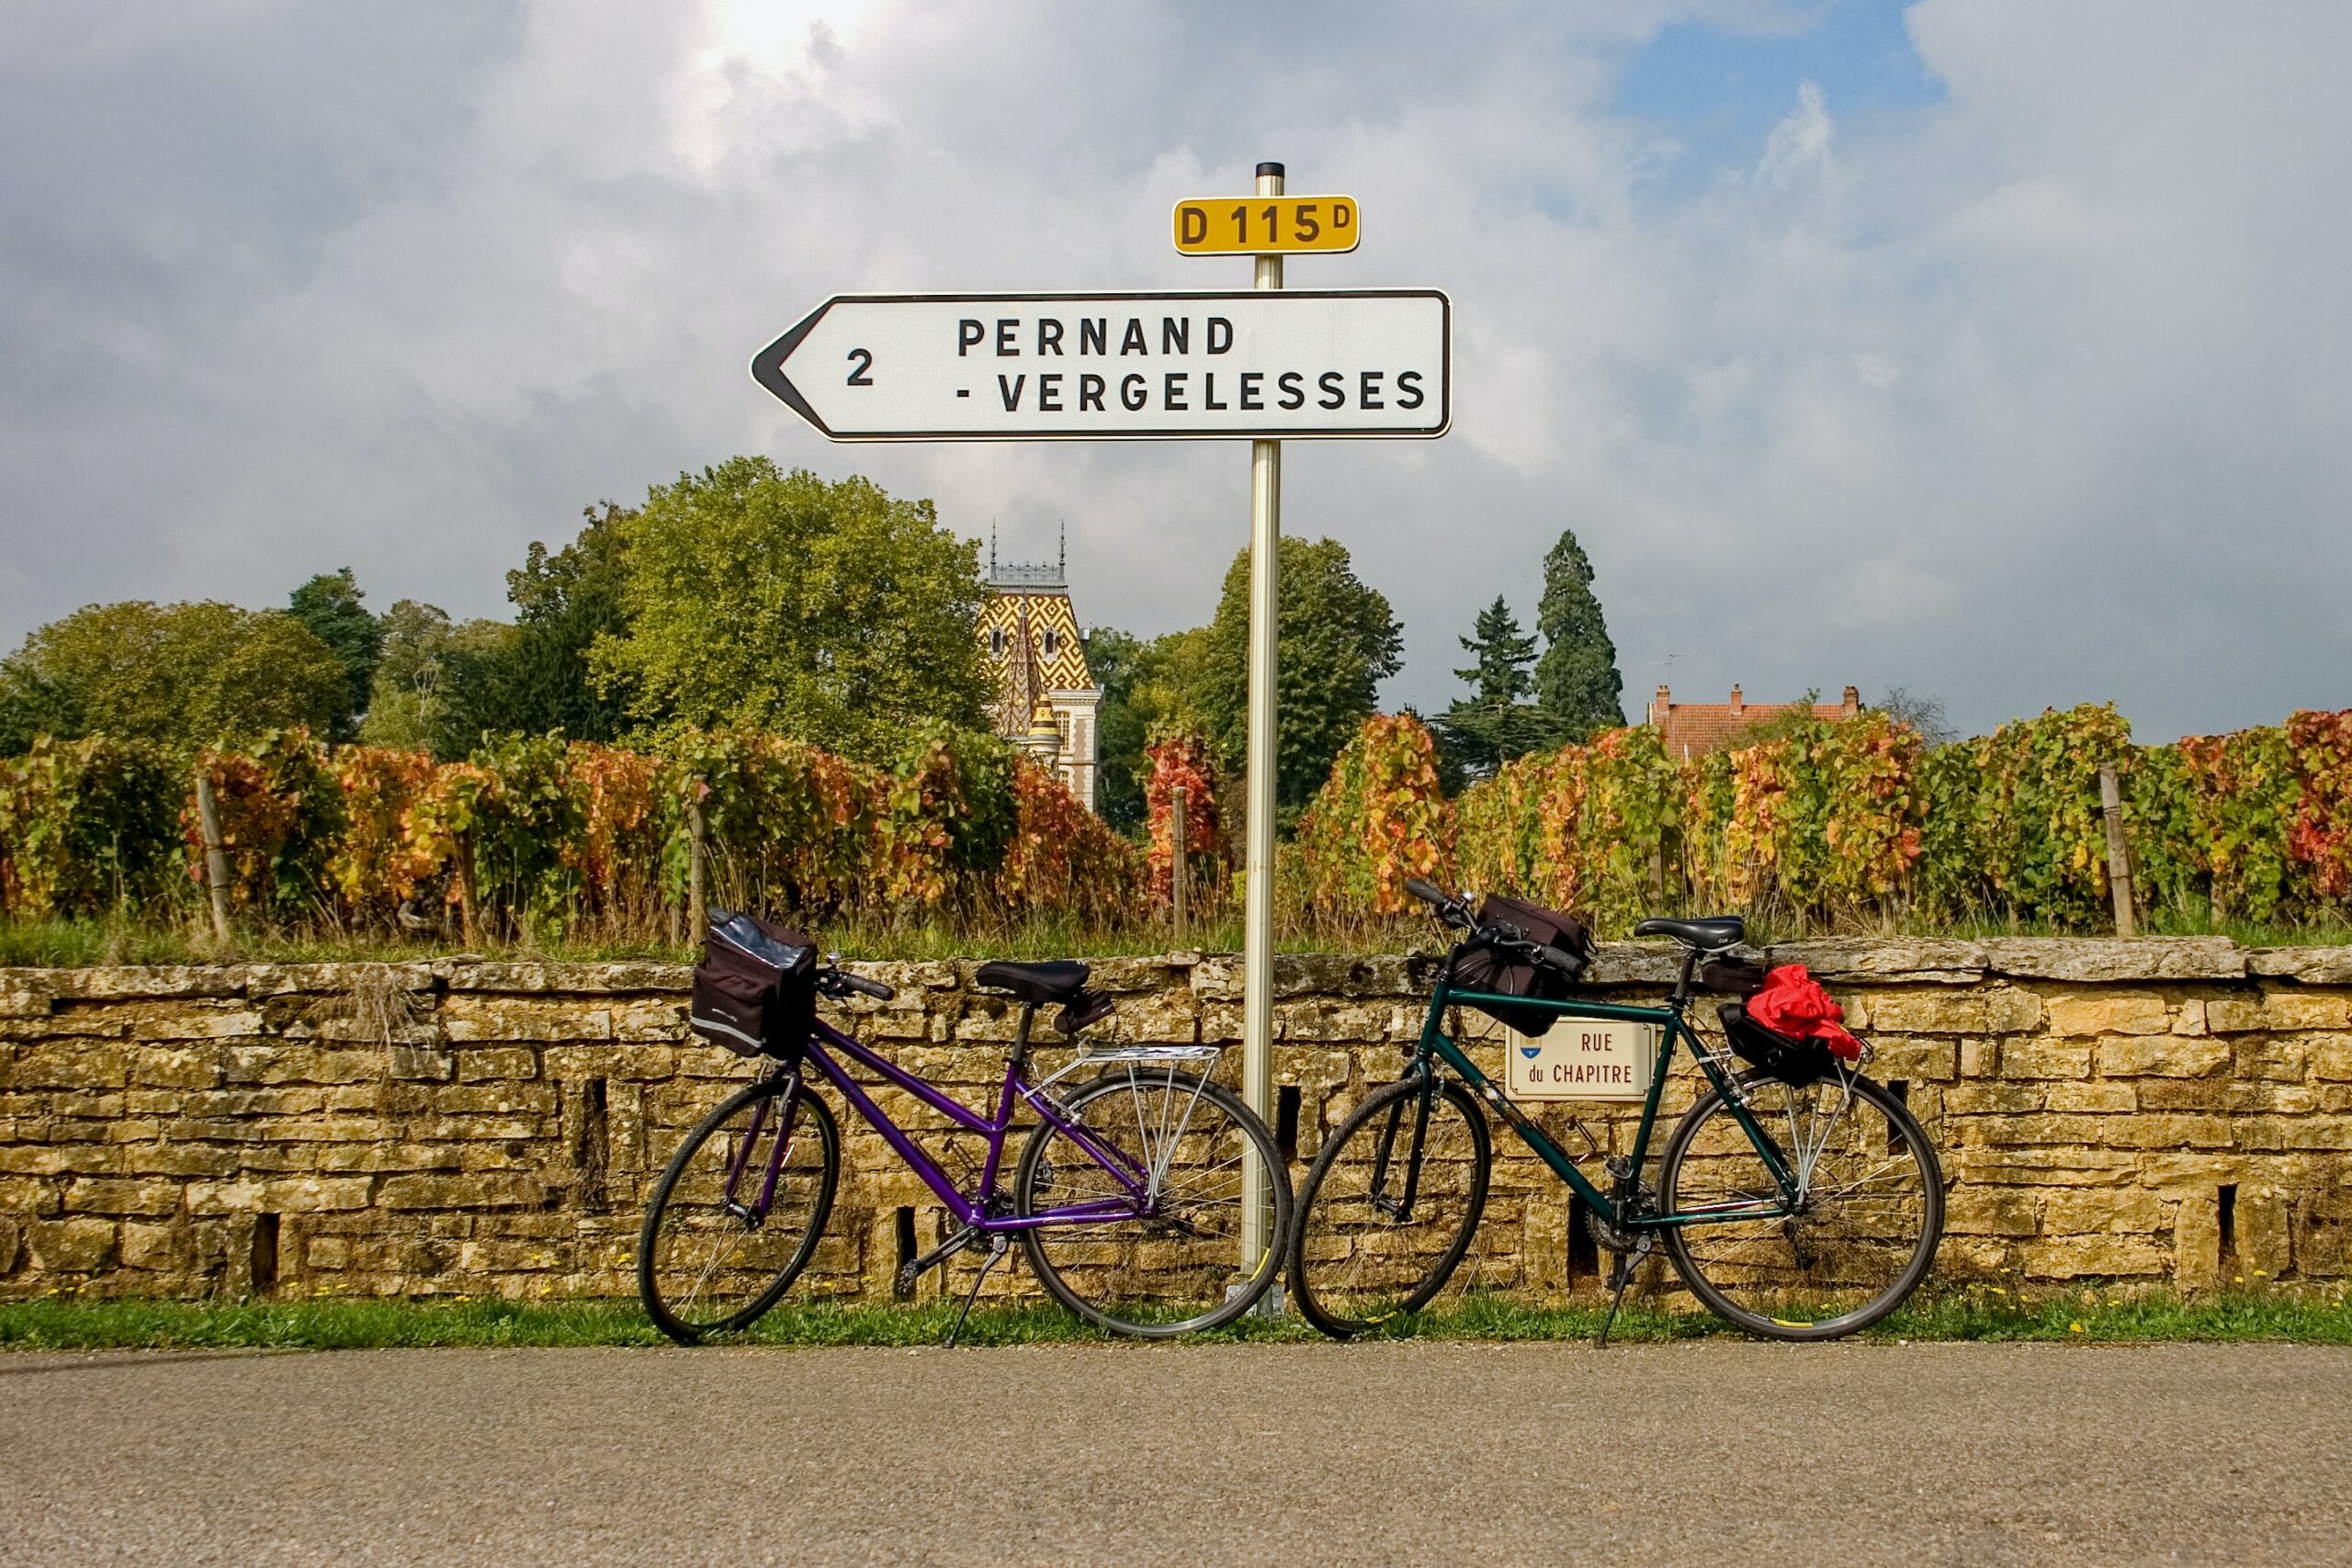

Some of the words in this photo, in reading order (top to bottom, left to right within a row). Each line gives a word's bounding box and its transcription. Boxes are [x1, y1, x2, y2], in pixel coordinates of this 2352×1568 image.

[1181, 207, 1208, 245] D
[958, 317, 1234, 357] PERNAND
[846, 347, 874, 387] 2
[1581, 1032, 1612, 1052] RUE
[1529, 1064, 1544, 1083] du
[1553, 1064, 1632, 1084] CHAPITRE
